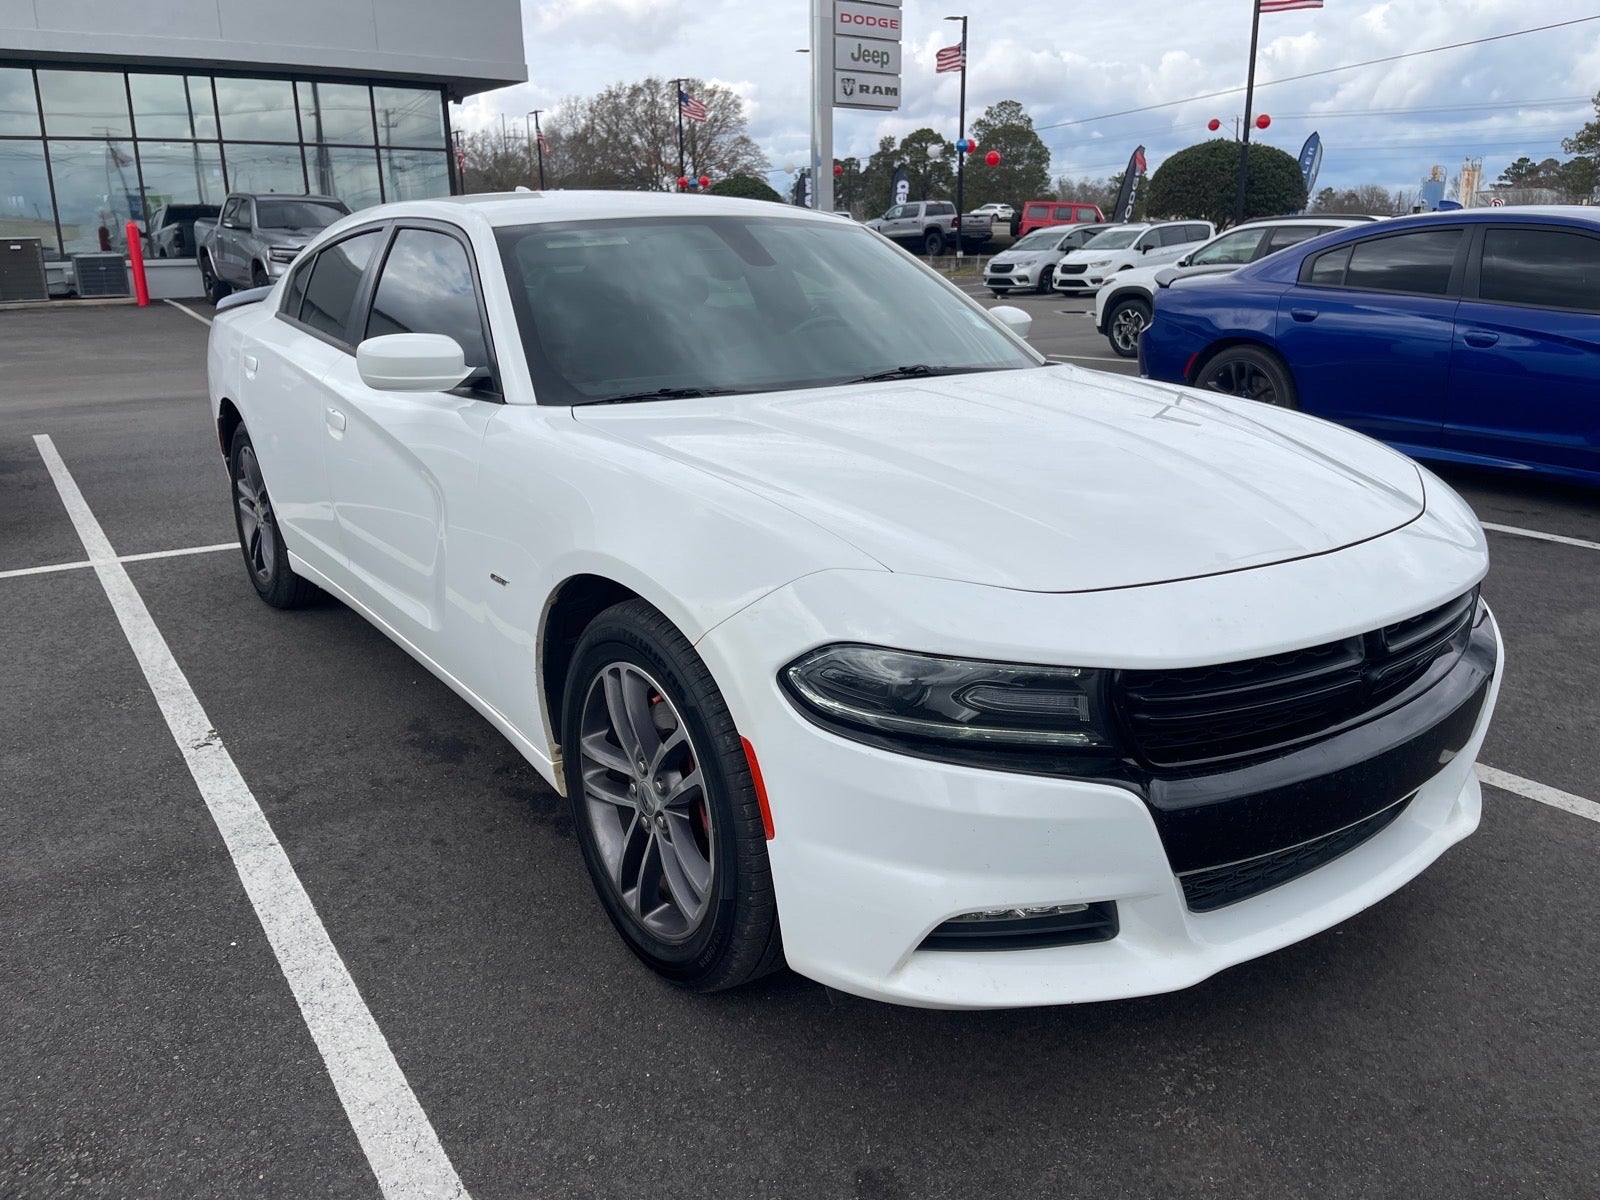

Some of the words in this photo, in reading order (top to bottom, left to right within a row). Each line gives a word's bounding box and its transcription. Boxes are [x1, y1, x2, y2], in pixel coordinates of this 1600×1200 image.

[840, 13, 899, 29] DODGE
[851, 43, 890, 68] Jeep
[859, 84, 898, 97] RAM
